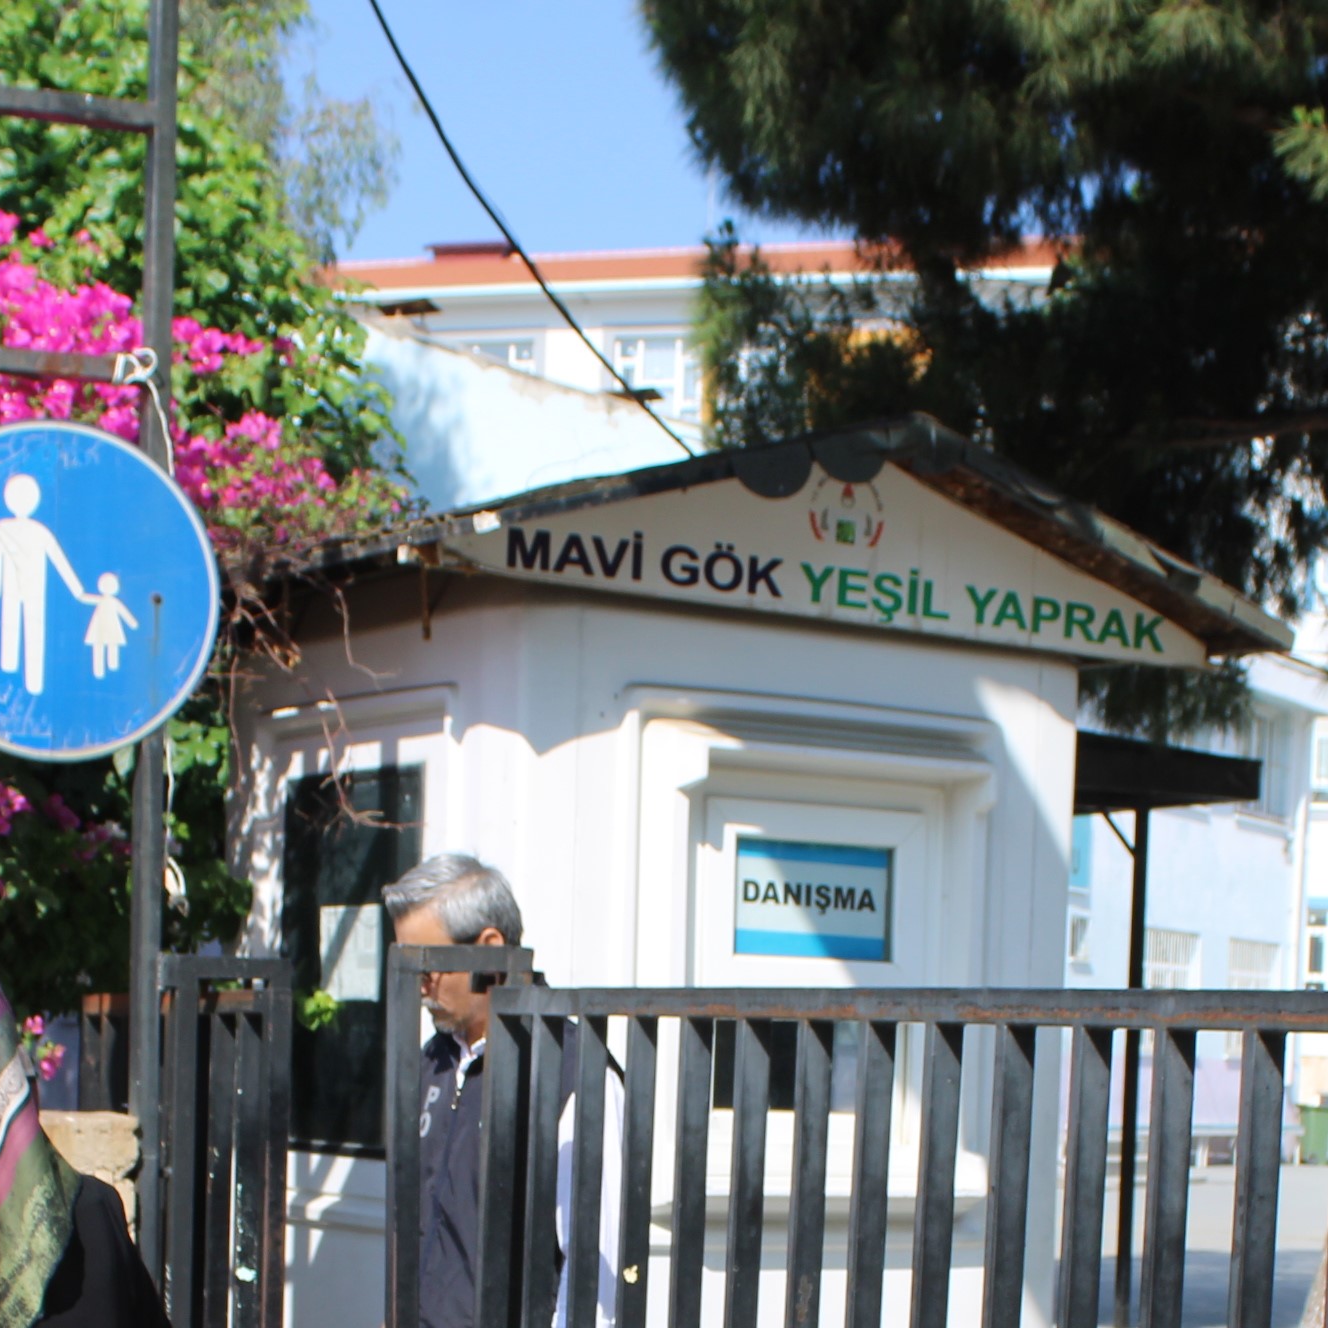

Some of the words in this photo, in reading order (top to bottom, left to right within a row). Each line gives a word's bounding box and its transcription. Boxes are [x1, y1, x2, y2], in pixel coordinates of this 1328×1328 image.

[507, 526, 644, 581] MAVİ
[661, 542, 783, 597] GÖK
[801, 562, 950, 623] YEŞİL
[965, 584, 1165, 652] YAPRAK
[743, 880, 875, 916] DANIŞMA
